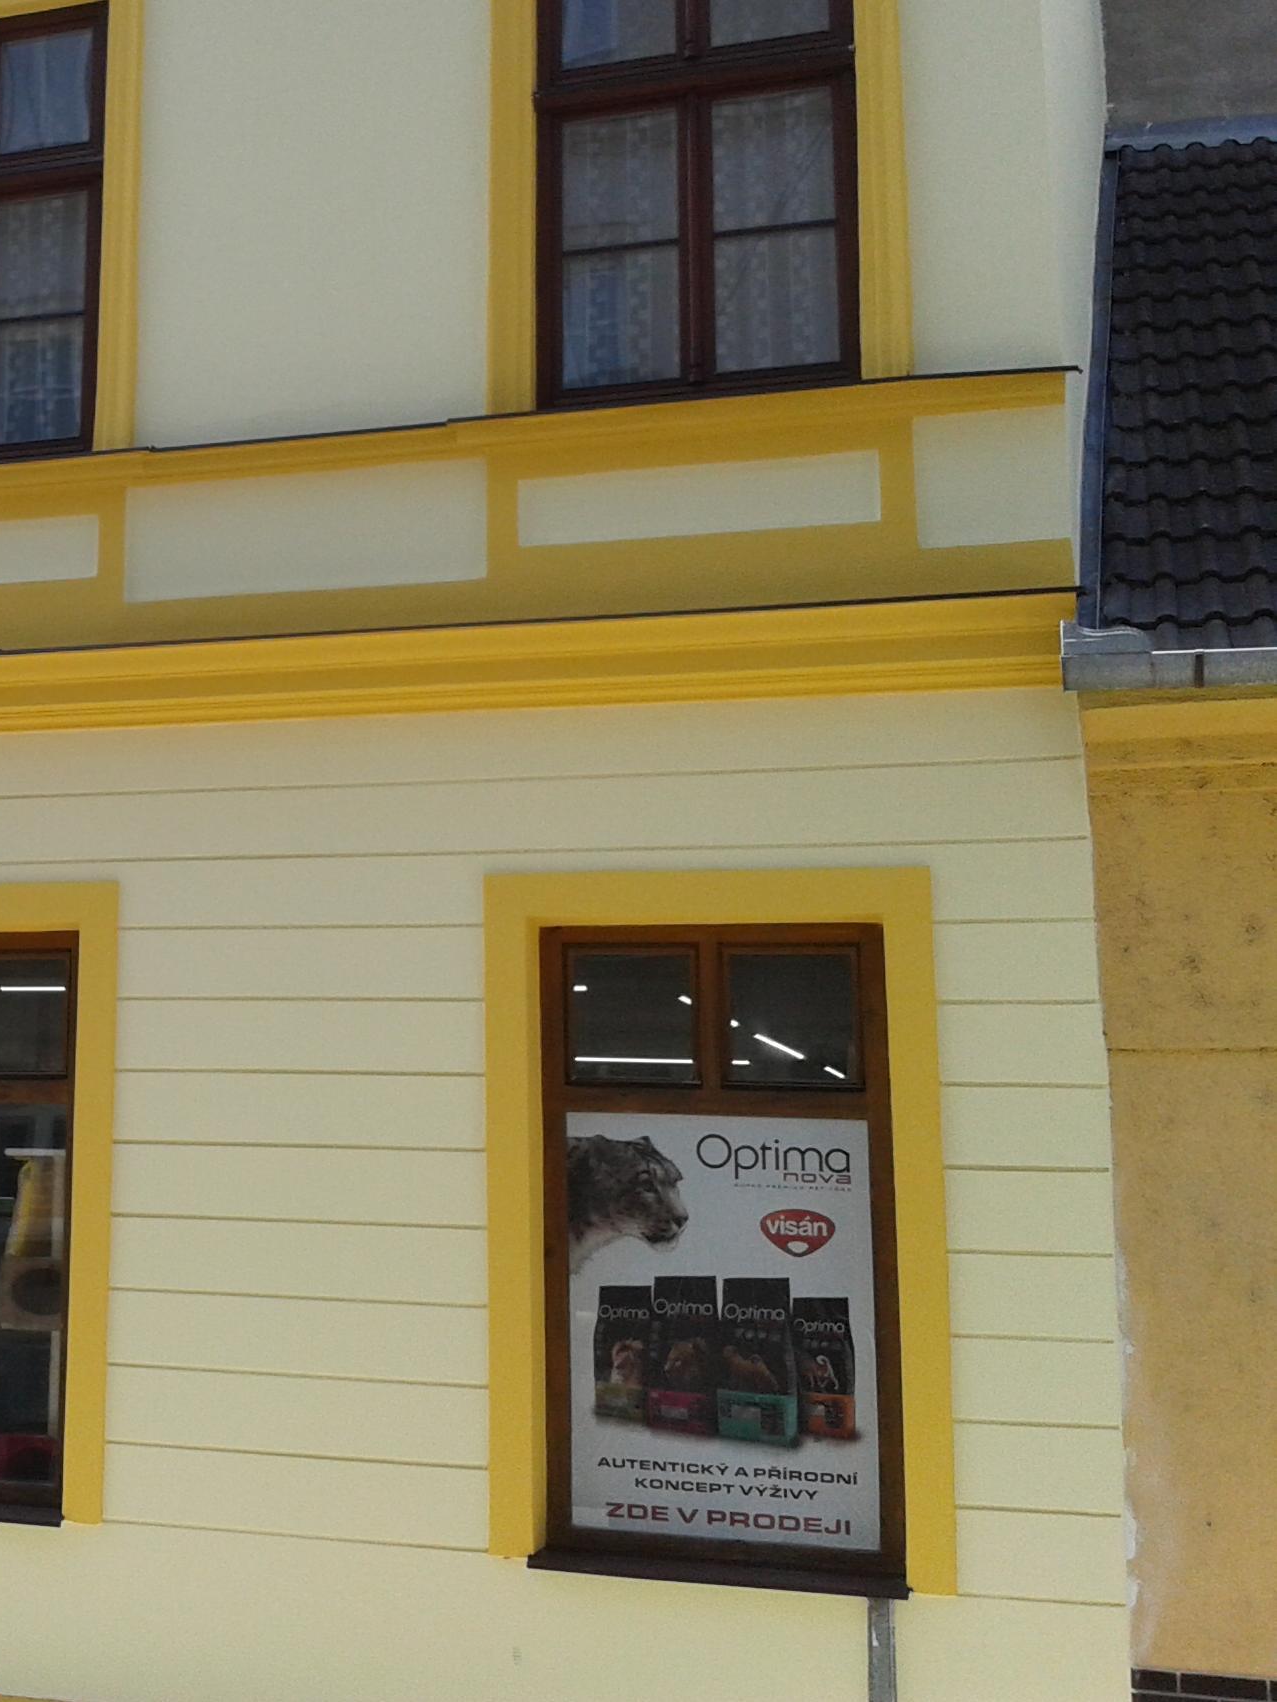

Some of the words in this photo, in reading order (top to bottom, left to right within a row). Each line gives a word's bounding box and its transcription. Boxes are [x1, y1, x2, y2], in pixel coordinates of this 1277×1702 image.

[696, 1133, 850, 1180] Optima
[783, 1172, 852, 1185] nova
[766, 1215, 828, 1237] visán
[598, 1304, 651, 1321] Optima
[652, 1299, 714, 1317] Optima
[724, 1303, 786, 1322] Optima
[597, 1456, 729, 1476] AUTENTICKÝ
[734, 1467, 750, 1478] A
[753, 1465, 858, 1486] PŘÍRODNÍ
[634, 1477, 735, 1495] KONCEPT
[738, 1483, 819, 1501] VÝŽIVY
[605, 1502, 670, 1522] ZDE
[677, 1508, 700, 1525] V
[707, 1509, 852, 1536] PRODEJI
